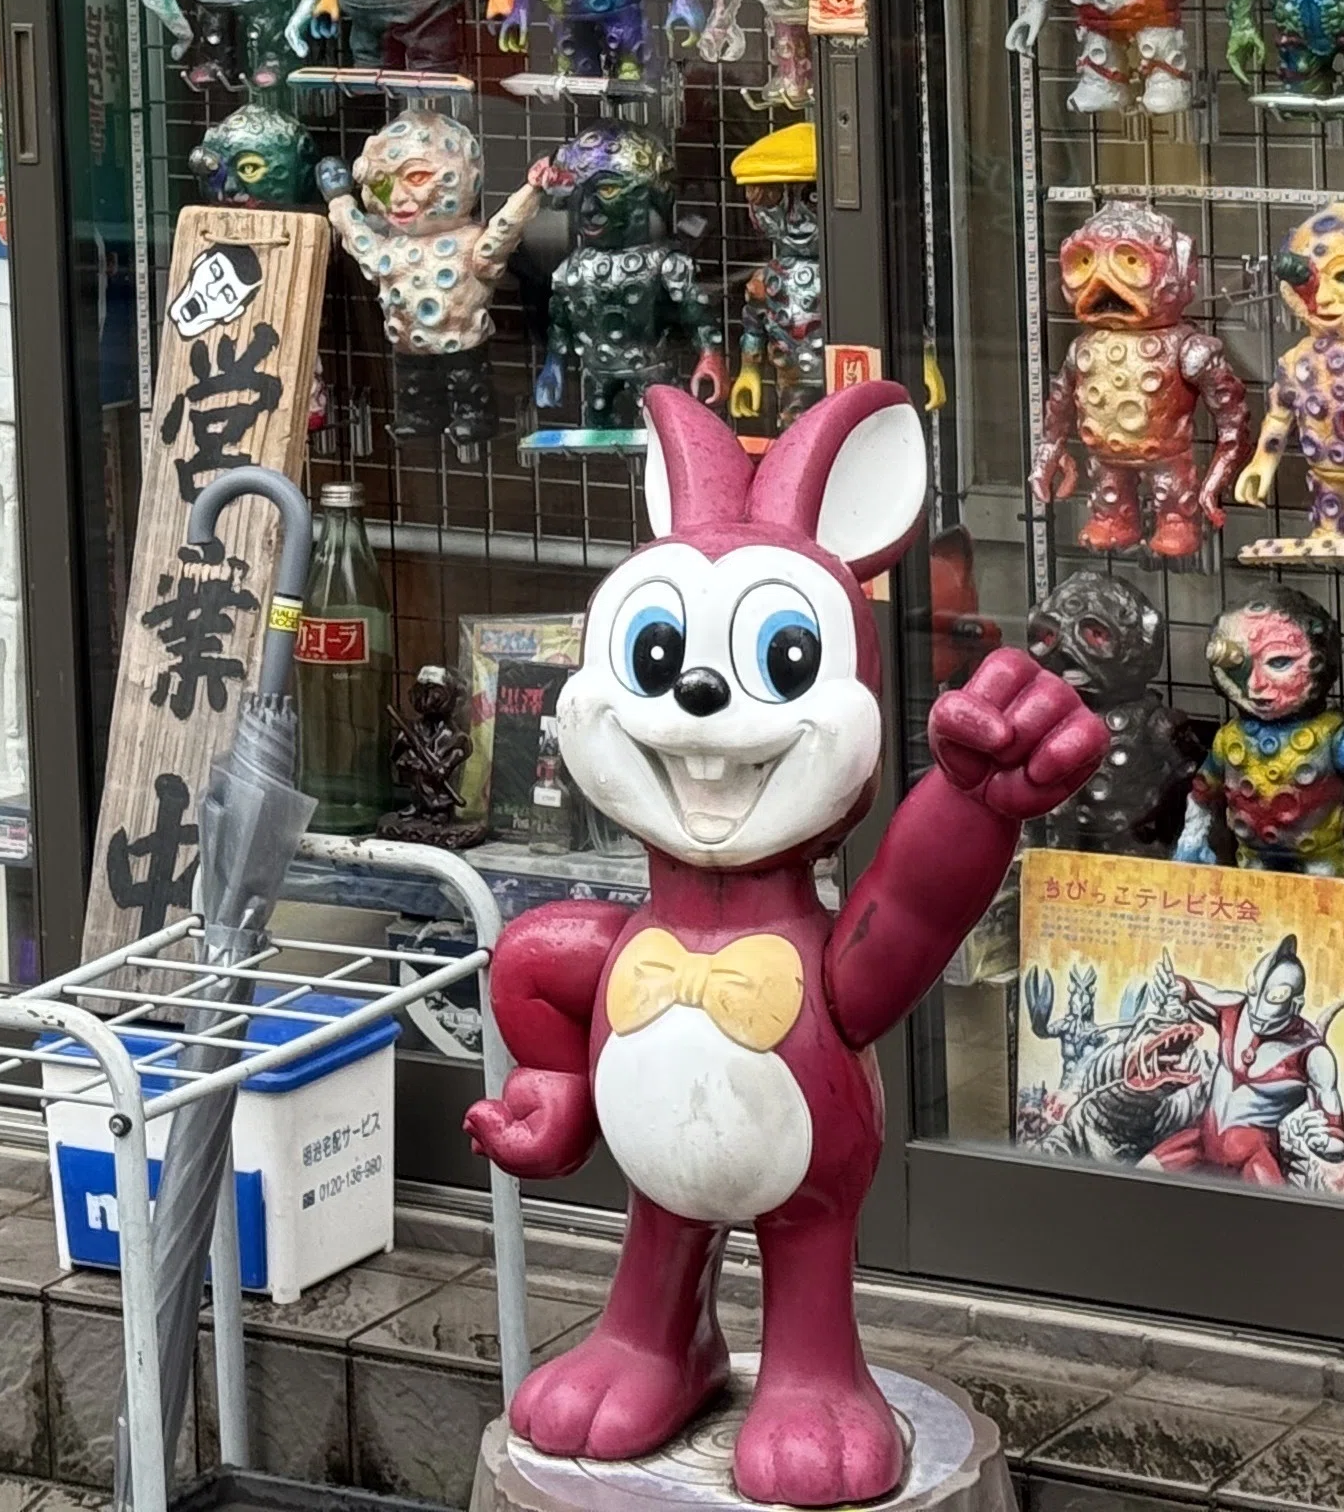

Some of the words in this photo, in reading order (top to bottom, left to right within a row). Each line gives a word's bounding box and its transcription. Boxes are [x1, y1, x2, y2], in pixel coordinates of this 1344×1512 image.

[106, 323, 282, 940] 営業中
[1043, 875, 1261, 924] ちびっこテレビ大会
[301, 1110, 382, 1167] 明治宅配サービス
